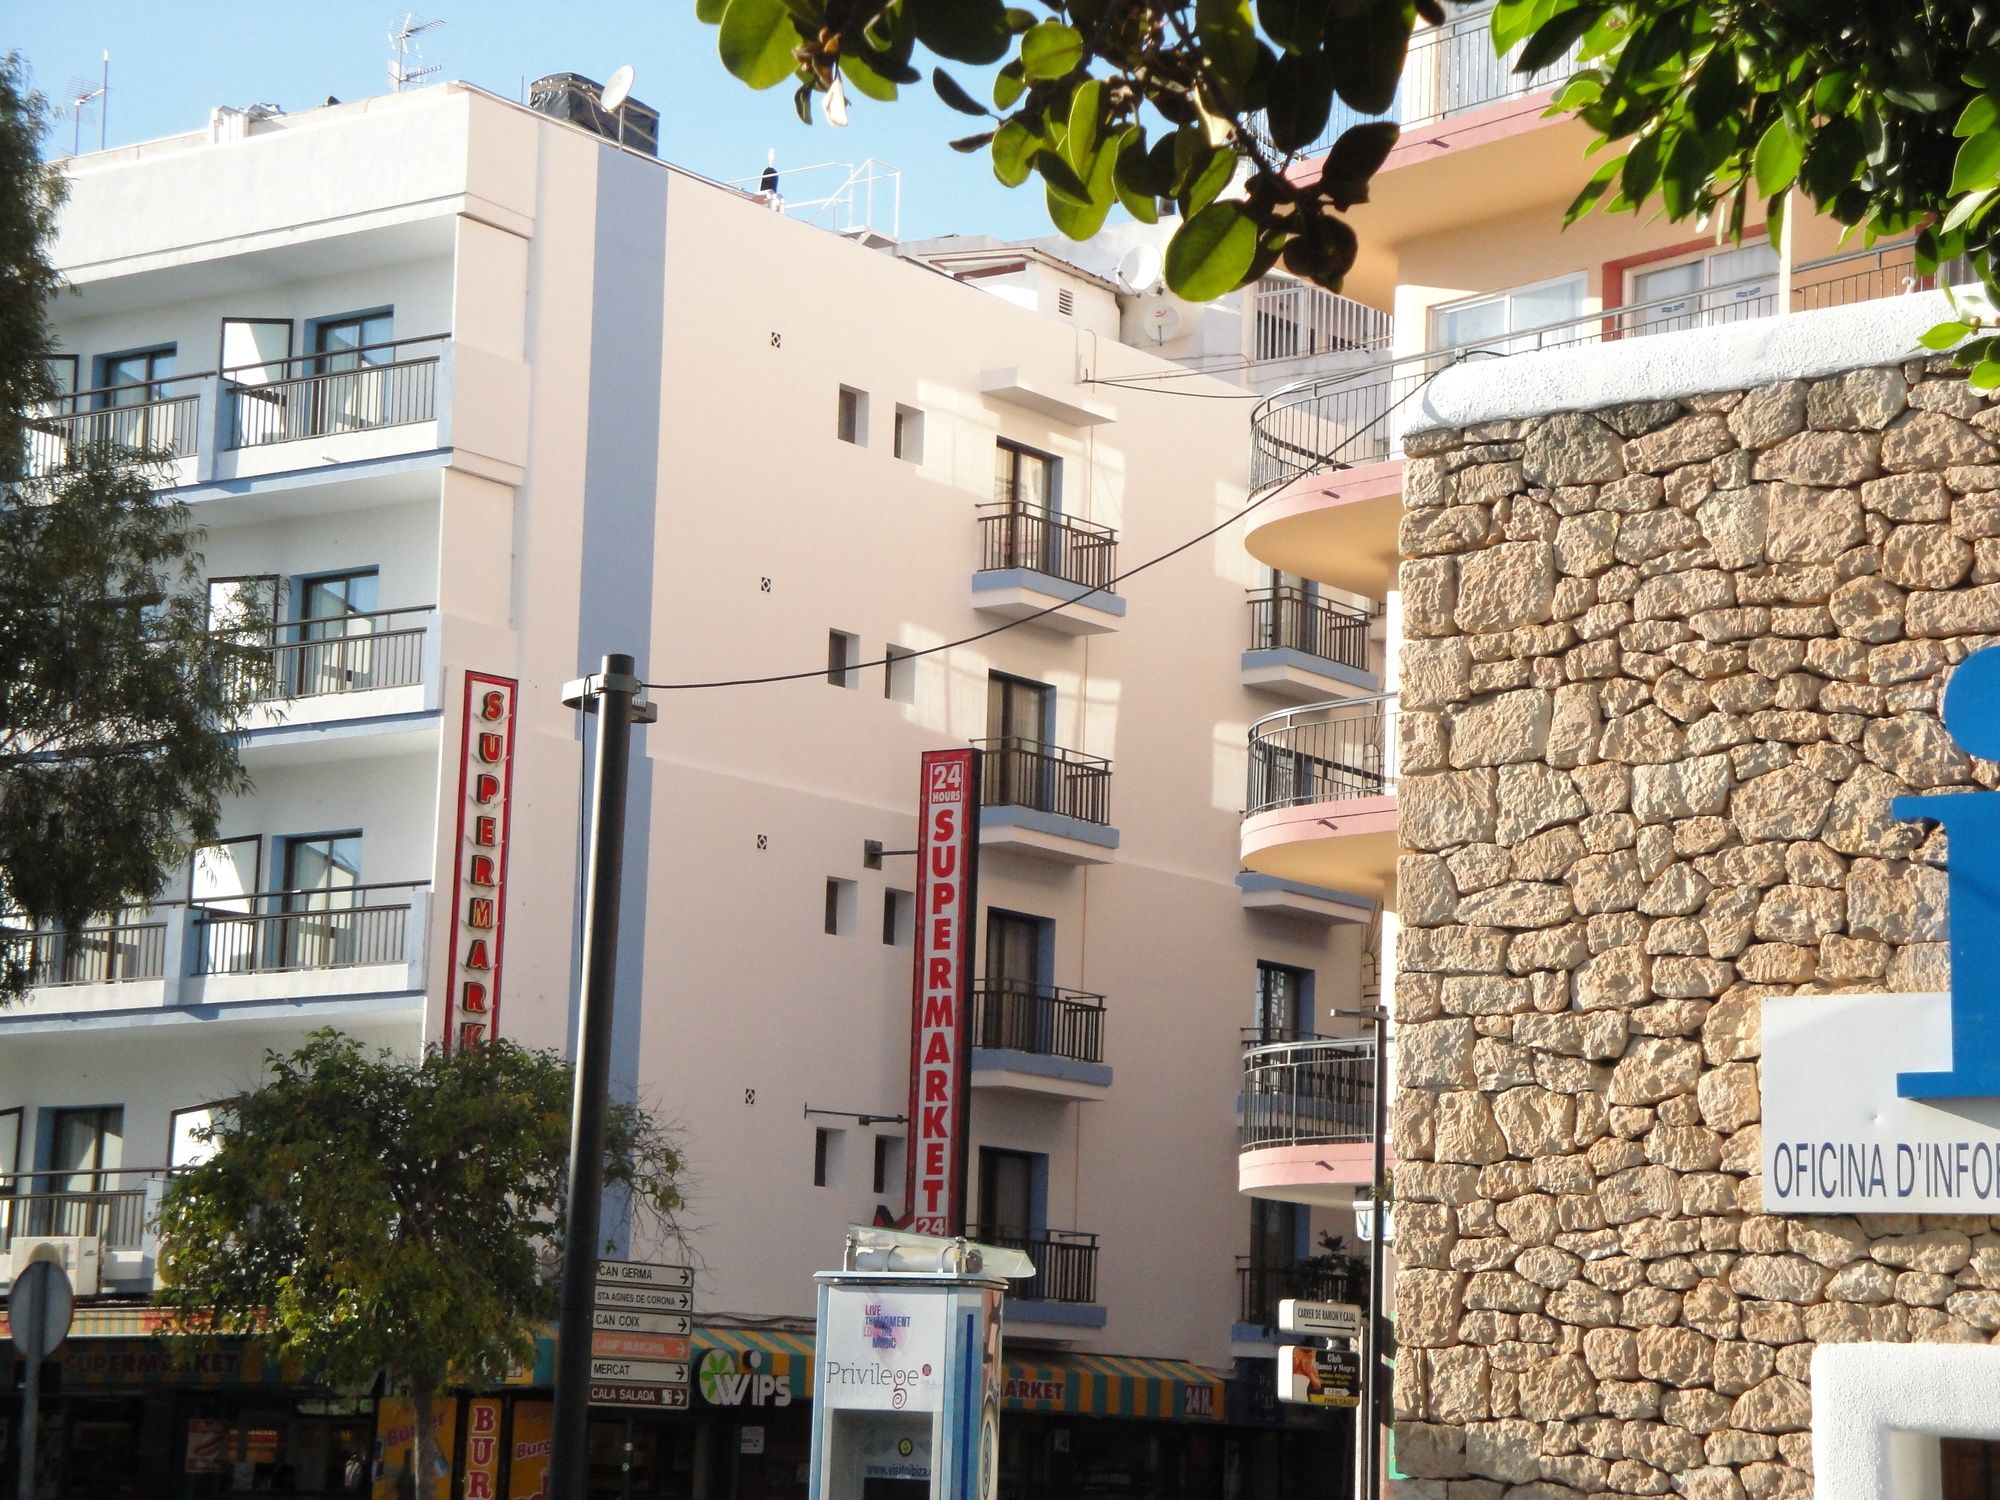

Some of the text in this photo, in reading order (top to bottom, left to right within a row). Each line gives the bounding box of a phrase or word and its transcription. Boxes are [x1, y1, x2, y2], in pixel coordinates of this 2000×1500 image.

[933, 765, 961, 789] 24
[931, 790, 961, 802] HOURS
[922, 808, 956, 1213] SUPERMARKET
[1773, 1141, 2000, 1199] OFICINA D'INFO
[918, 1218, 946, 1236] 24
[600, 1265, 618, 1277] CAN
[635, 1294, 646, 1304] DE
[865, 1305, 881, 1316] LIVE
[1297, 1307, 1314, 1319] CARRER
[1315, 1309, 1321, 1320] DE
[596, 1314, 640, 1328] CAN COIX
[873, 1316, 912, 1328] MOMENT
[1327, 1353, 1342, 1364] Club
[594, 1363, 630, 1376] MERCAT
[826, 1361, 919, 1410] Privilege
[592, 1387, 655, 1402] CALA SALADA
